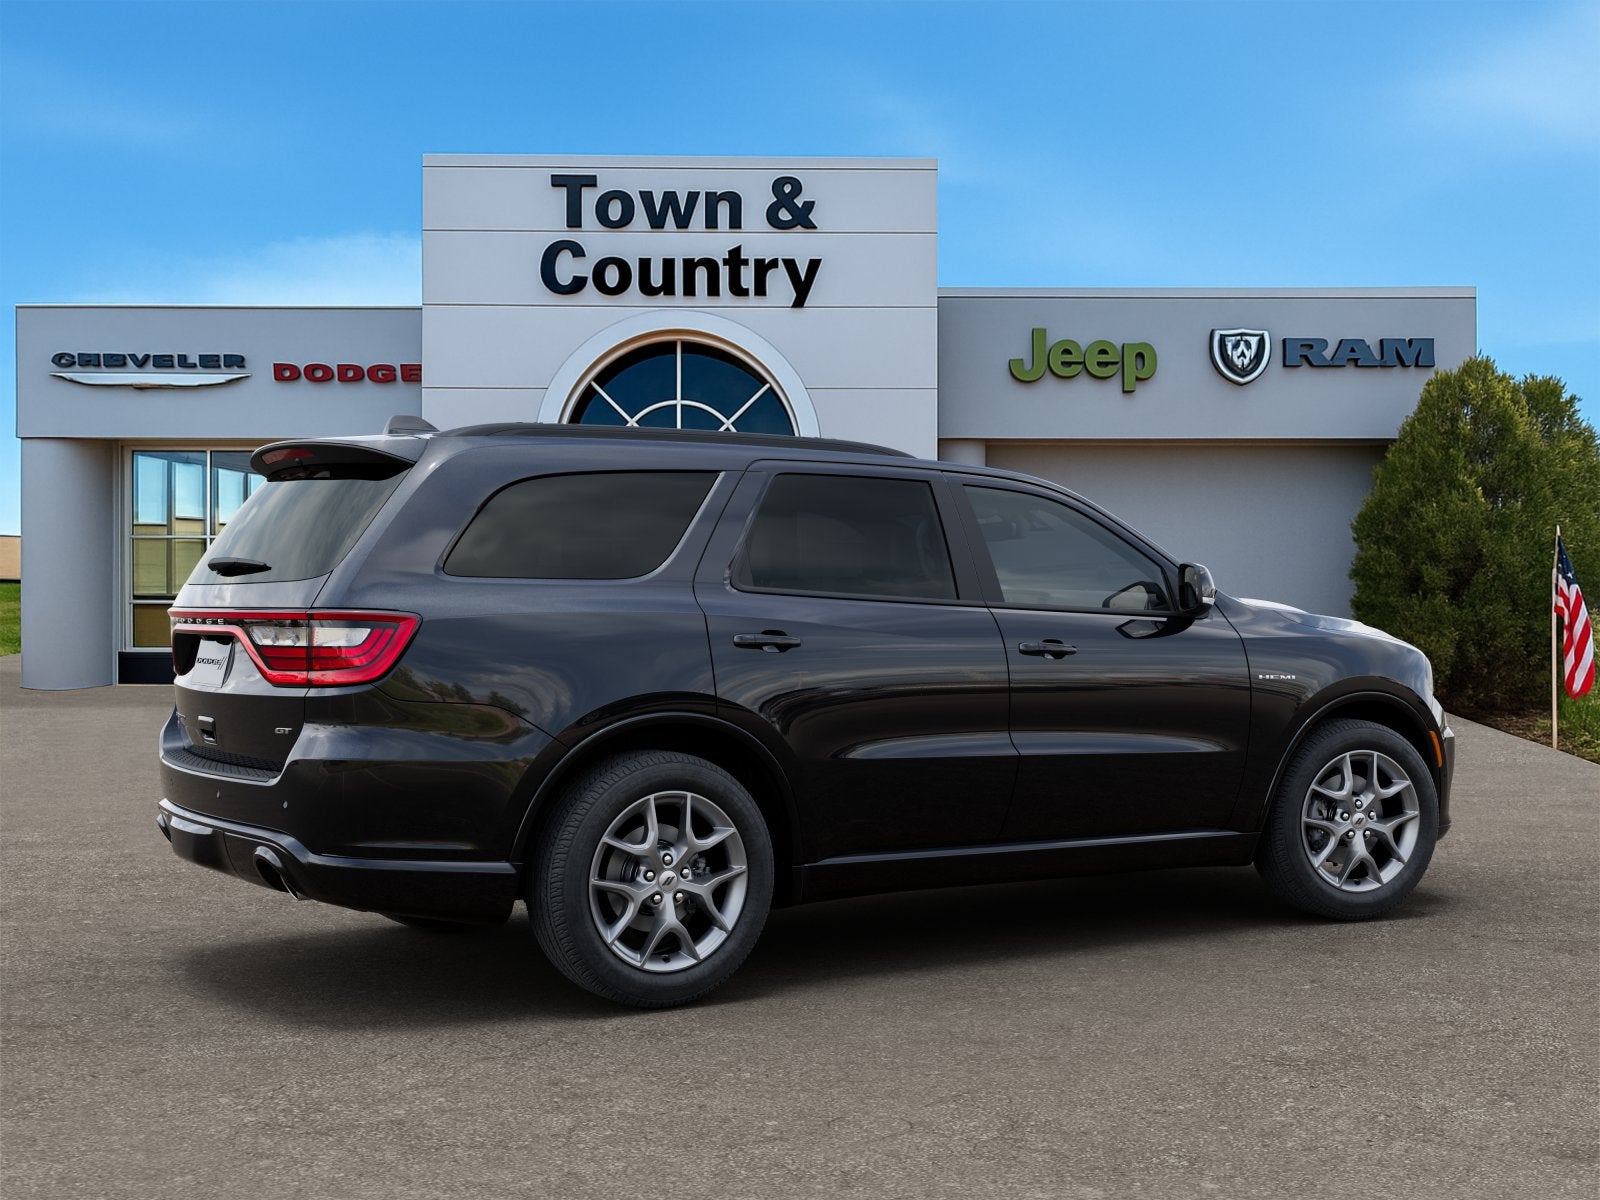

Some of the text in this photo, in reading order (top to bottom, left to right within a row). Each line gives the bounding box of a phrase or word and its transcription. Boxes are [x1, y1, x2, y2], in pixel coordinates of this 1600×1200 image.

[551, 174, 818, 230] Town &
[540, 240, 822, 308] Country
[272, 362, 421, 383] DODGE
[1008, 328, 1157, 393] Jeep
[1282, 337, 1436, 368] RAM
[274, 727, 293, 735] GT
